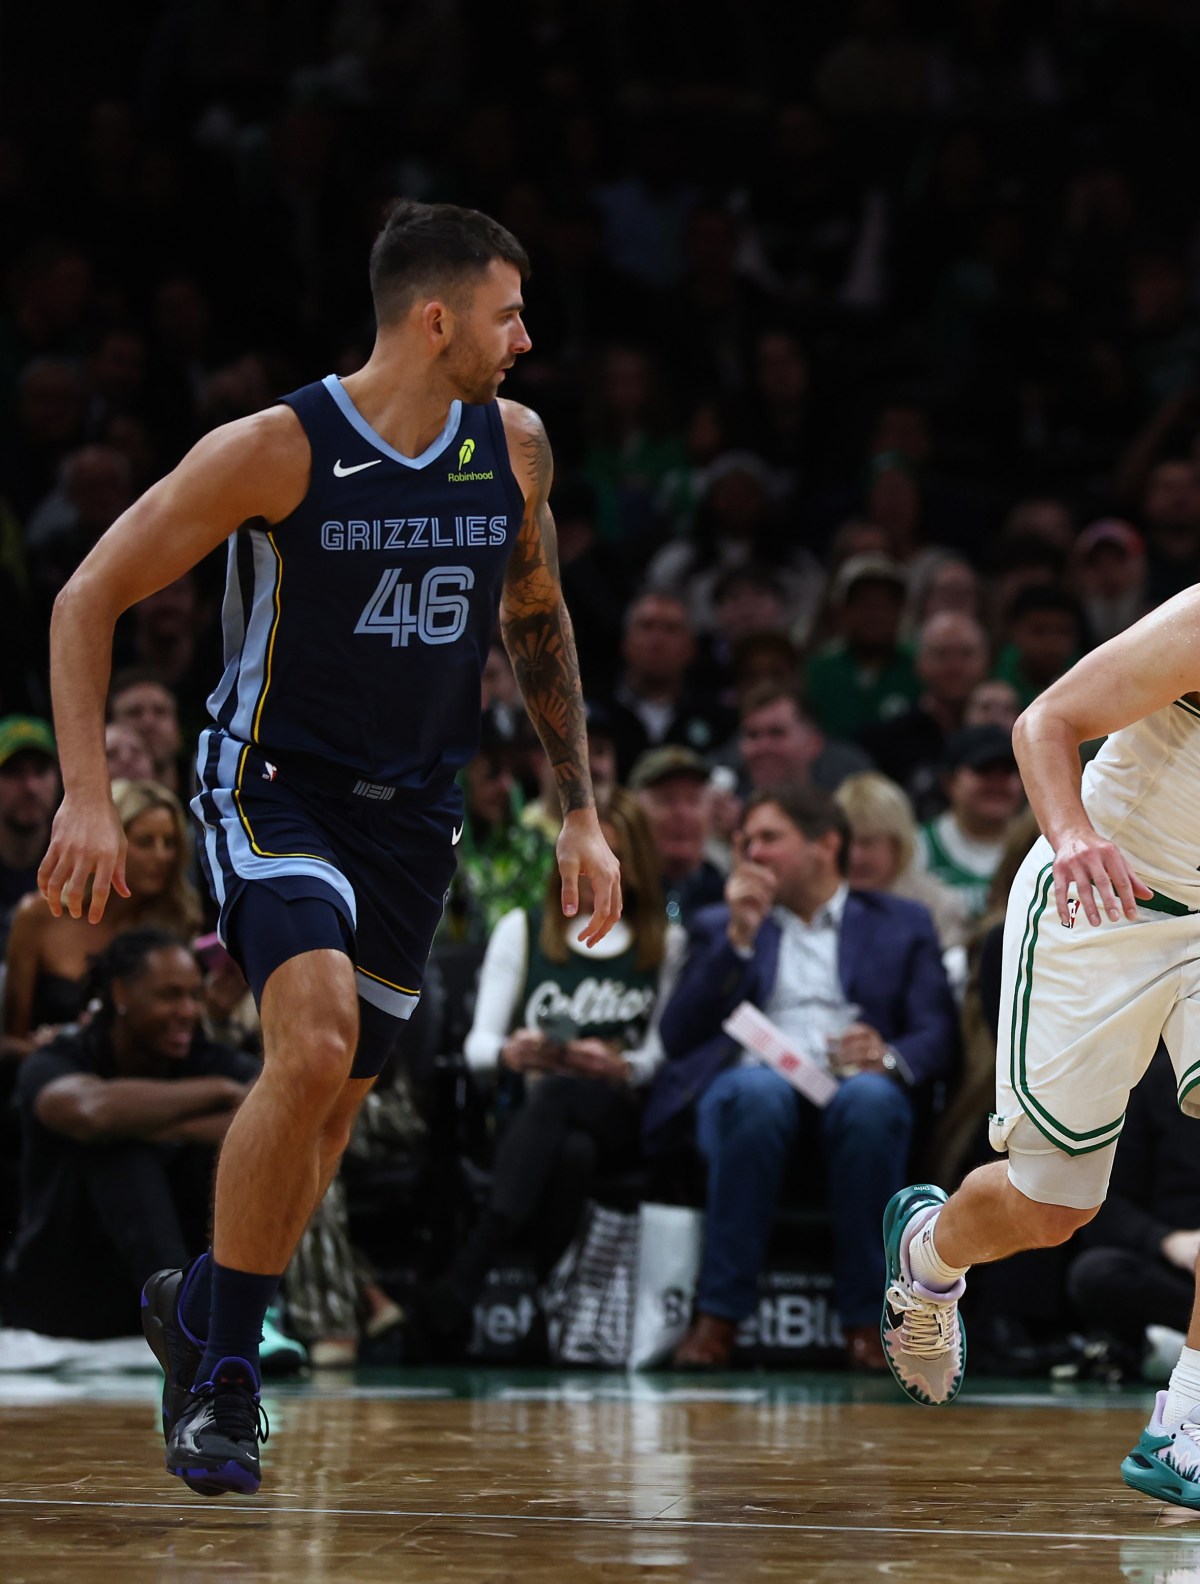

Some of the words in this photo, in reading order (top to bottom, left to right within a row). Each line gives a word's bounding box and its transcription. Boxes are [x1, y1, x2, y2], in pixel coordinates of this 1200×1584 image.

[447, 470, 494, 482] Robinhood
[320, 515, 508, 551] GRIZZLIES
[353, 565, 475, 648] 46
